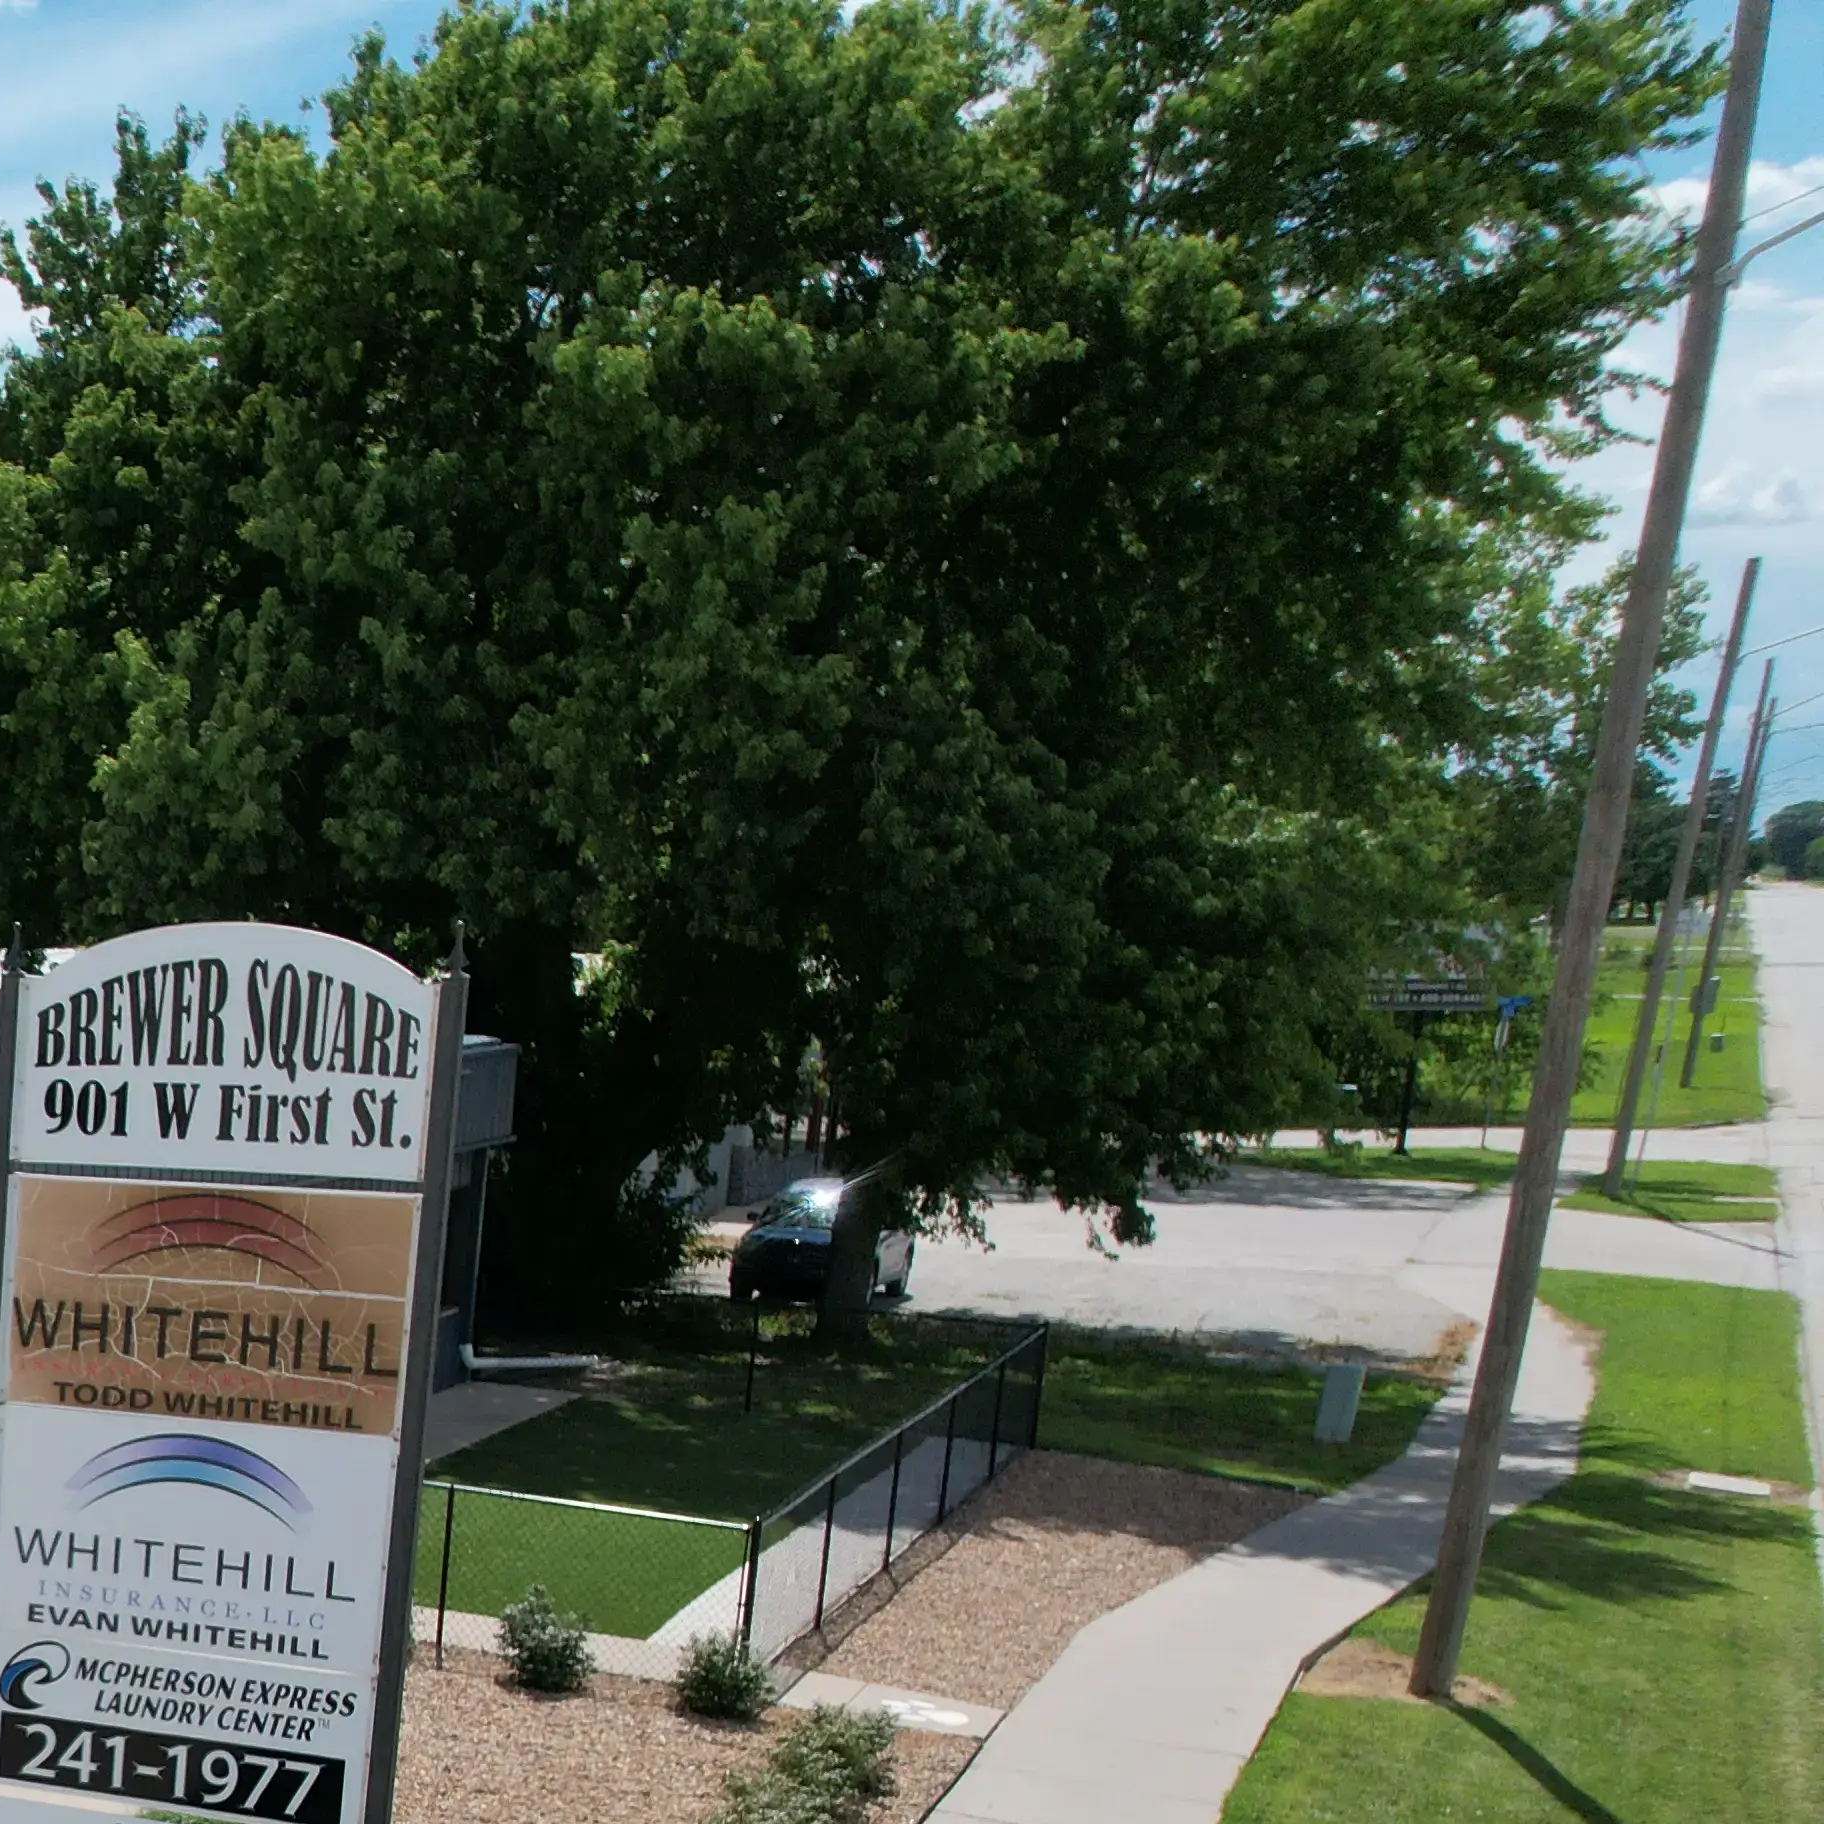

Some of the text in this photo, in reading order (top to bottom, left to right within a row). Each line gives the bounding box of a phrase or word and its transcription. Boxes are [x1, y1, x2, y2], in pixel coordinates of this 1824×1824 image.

[35, 958, 422, 1083] BREWER SQUARE
[44, 1079, 413, 1150] 901 W First St.
[13, 1297, 398, 1378] WHITEHILL
[53, 1381, 364, 1430] TODD WHITEHILL
[13, 1525, 357, 1603] WHITEHILL
[27, 1604, 330, 1660] EVAN WHITEHILL
[38, 1579, 327, 1630] INSURANCE LLC
[75, 1658, 358, 1716] MCPHERSON EXPRESS
[94, 1690, 214, 1726] LAUNDRY
[16, 1723, 327, 1816] 241-1977
